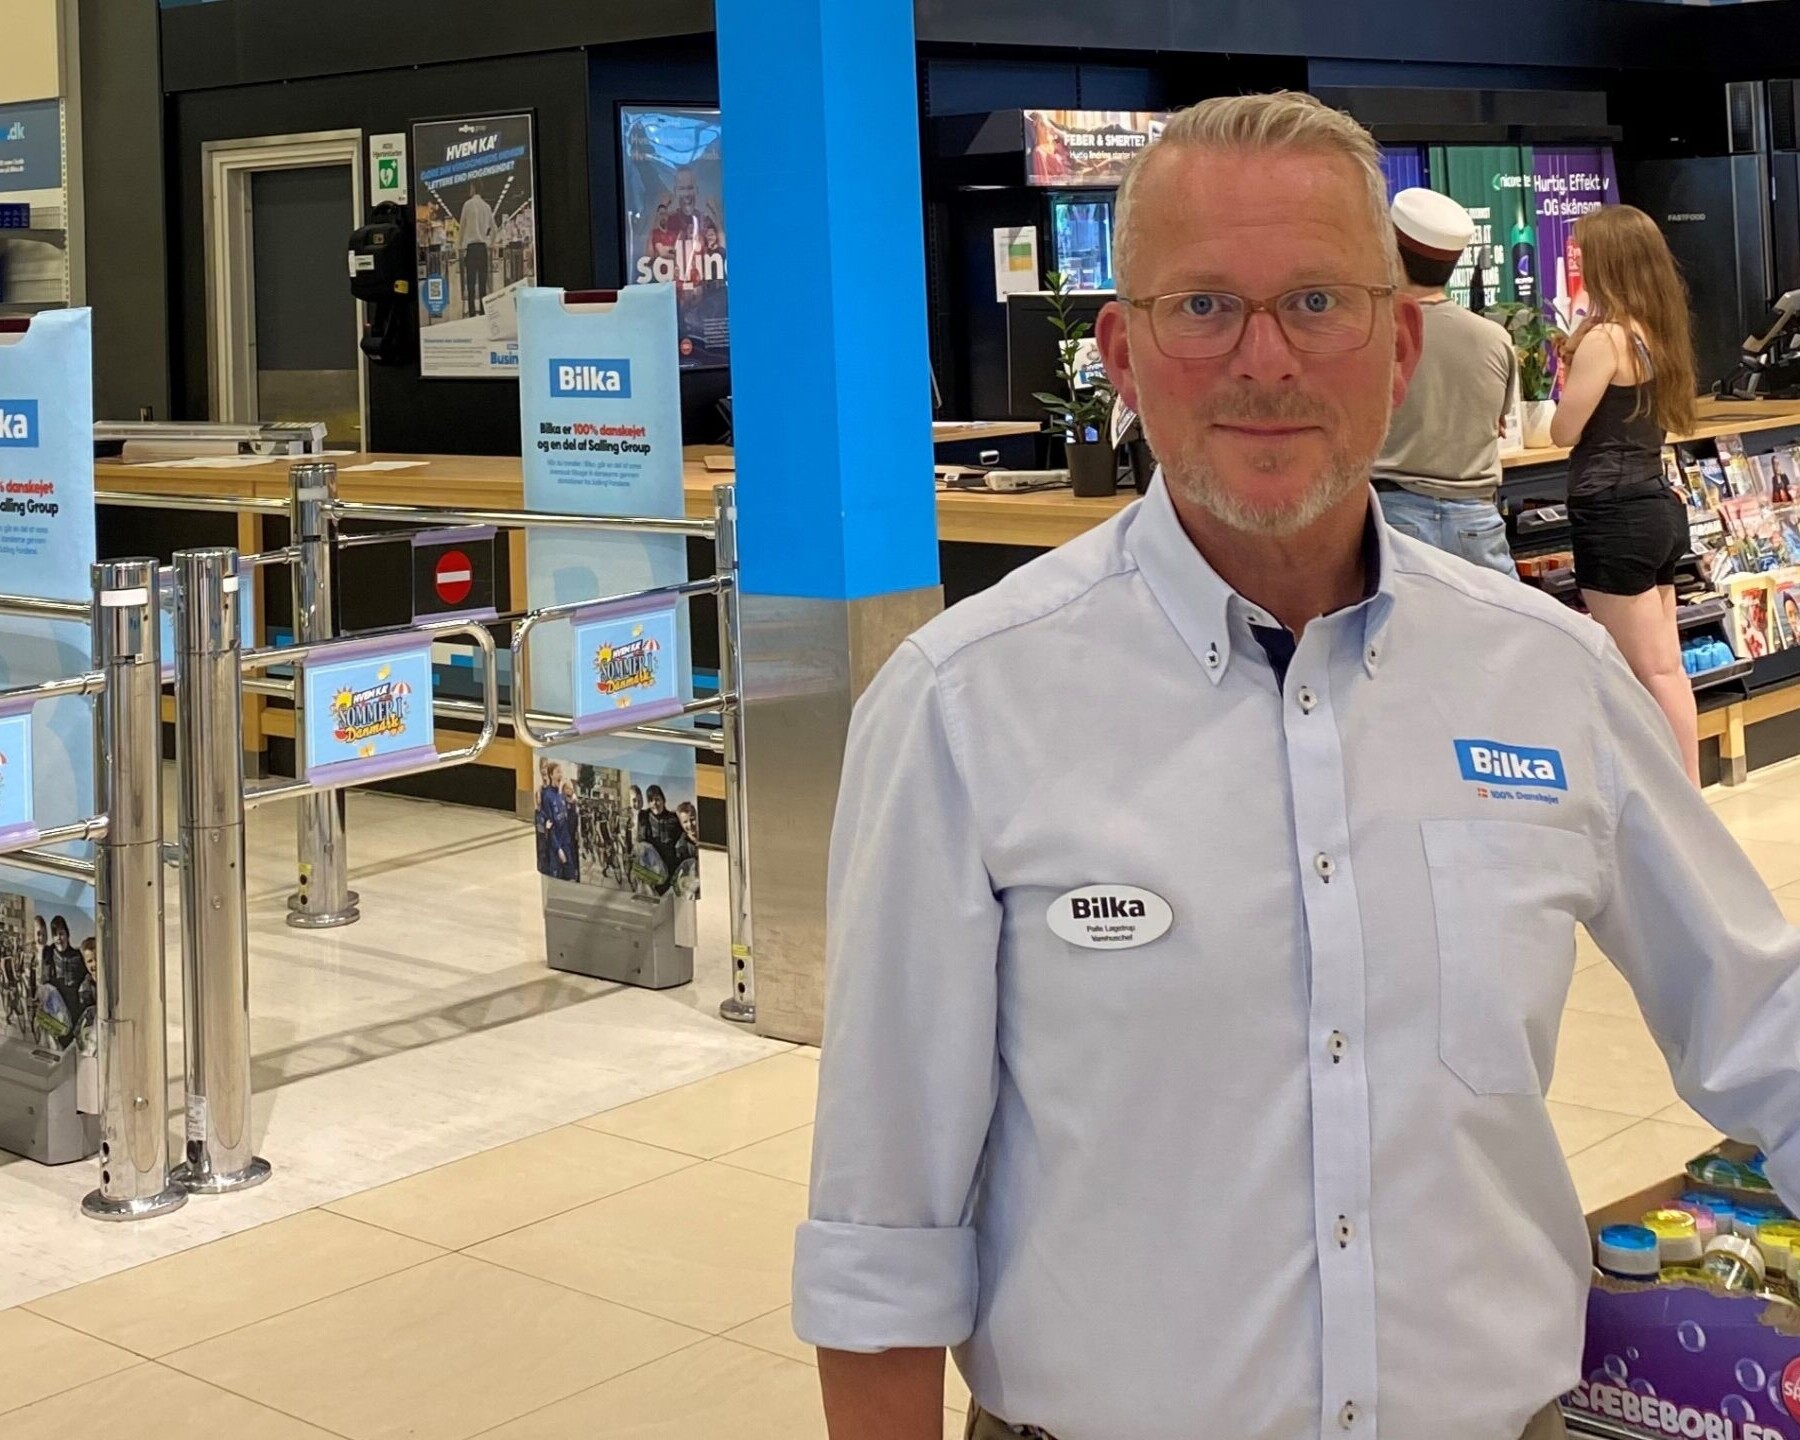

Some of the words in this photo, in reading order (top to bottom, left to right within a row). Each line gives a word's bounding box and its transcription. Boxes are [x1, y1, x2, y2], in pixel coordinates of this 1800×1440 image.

[446, 139, 478, 162] HVEM
[1063, 133, 1095, 147] FEBER
[1104, 134, 1146, 147] SMERTE?
[490, 352, 519, 365] Busin
[558, 365, 621, 392] Bilka
[540, 422, 561, 435] Bilka
[562, 425, 572, 435] er
[573, 423, 598, 437] 100%
[537, 441, 549, 453] og
[550, 441, 561, 450] en
[562, 439, 576, 451] del
[577, 440, 587, 451] af
[588, 440, 619, 456] Salling
[620, 441, 651, 456] Group
[27, 499, 59, 518] Group
[338, 699, 396, 728] SOMMER
[345, 715, 401, 743] Danmark
[1469, 746, 1557, 781] Bilka
[1490, 789, 1515, 800] 100%
[1071, 896, 1146, 919] Bilka
